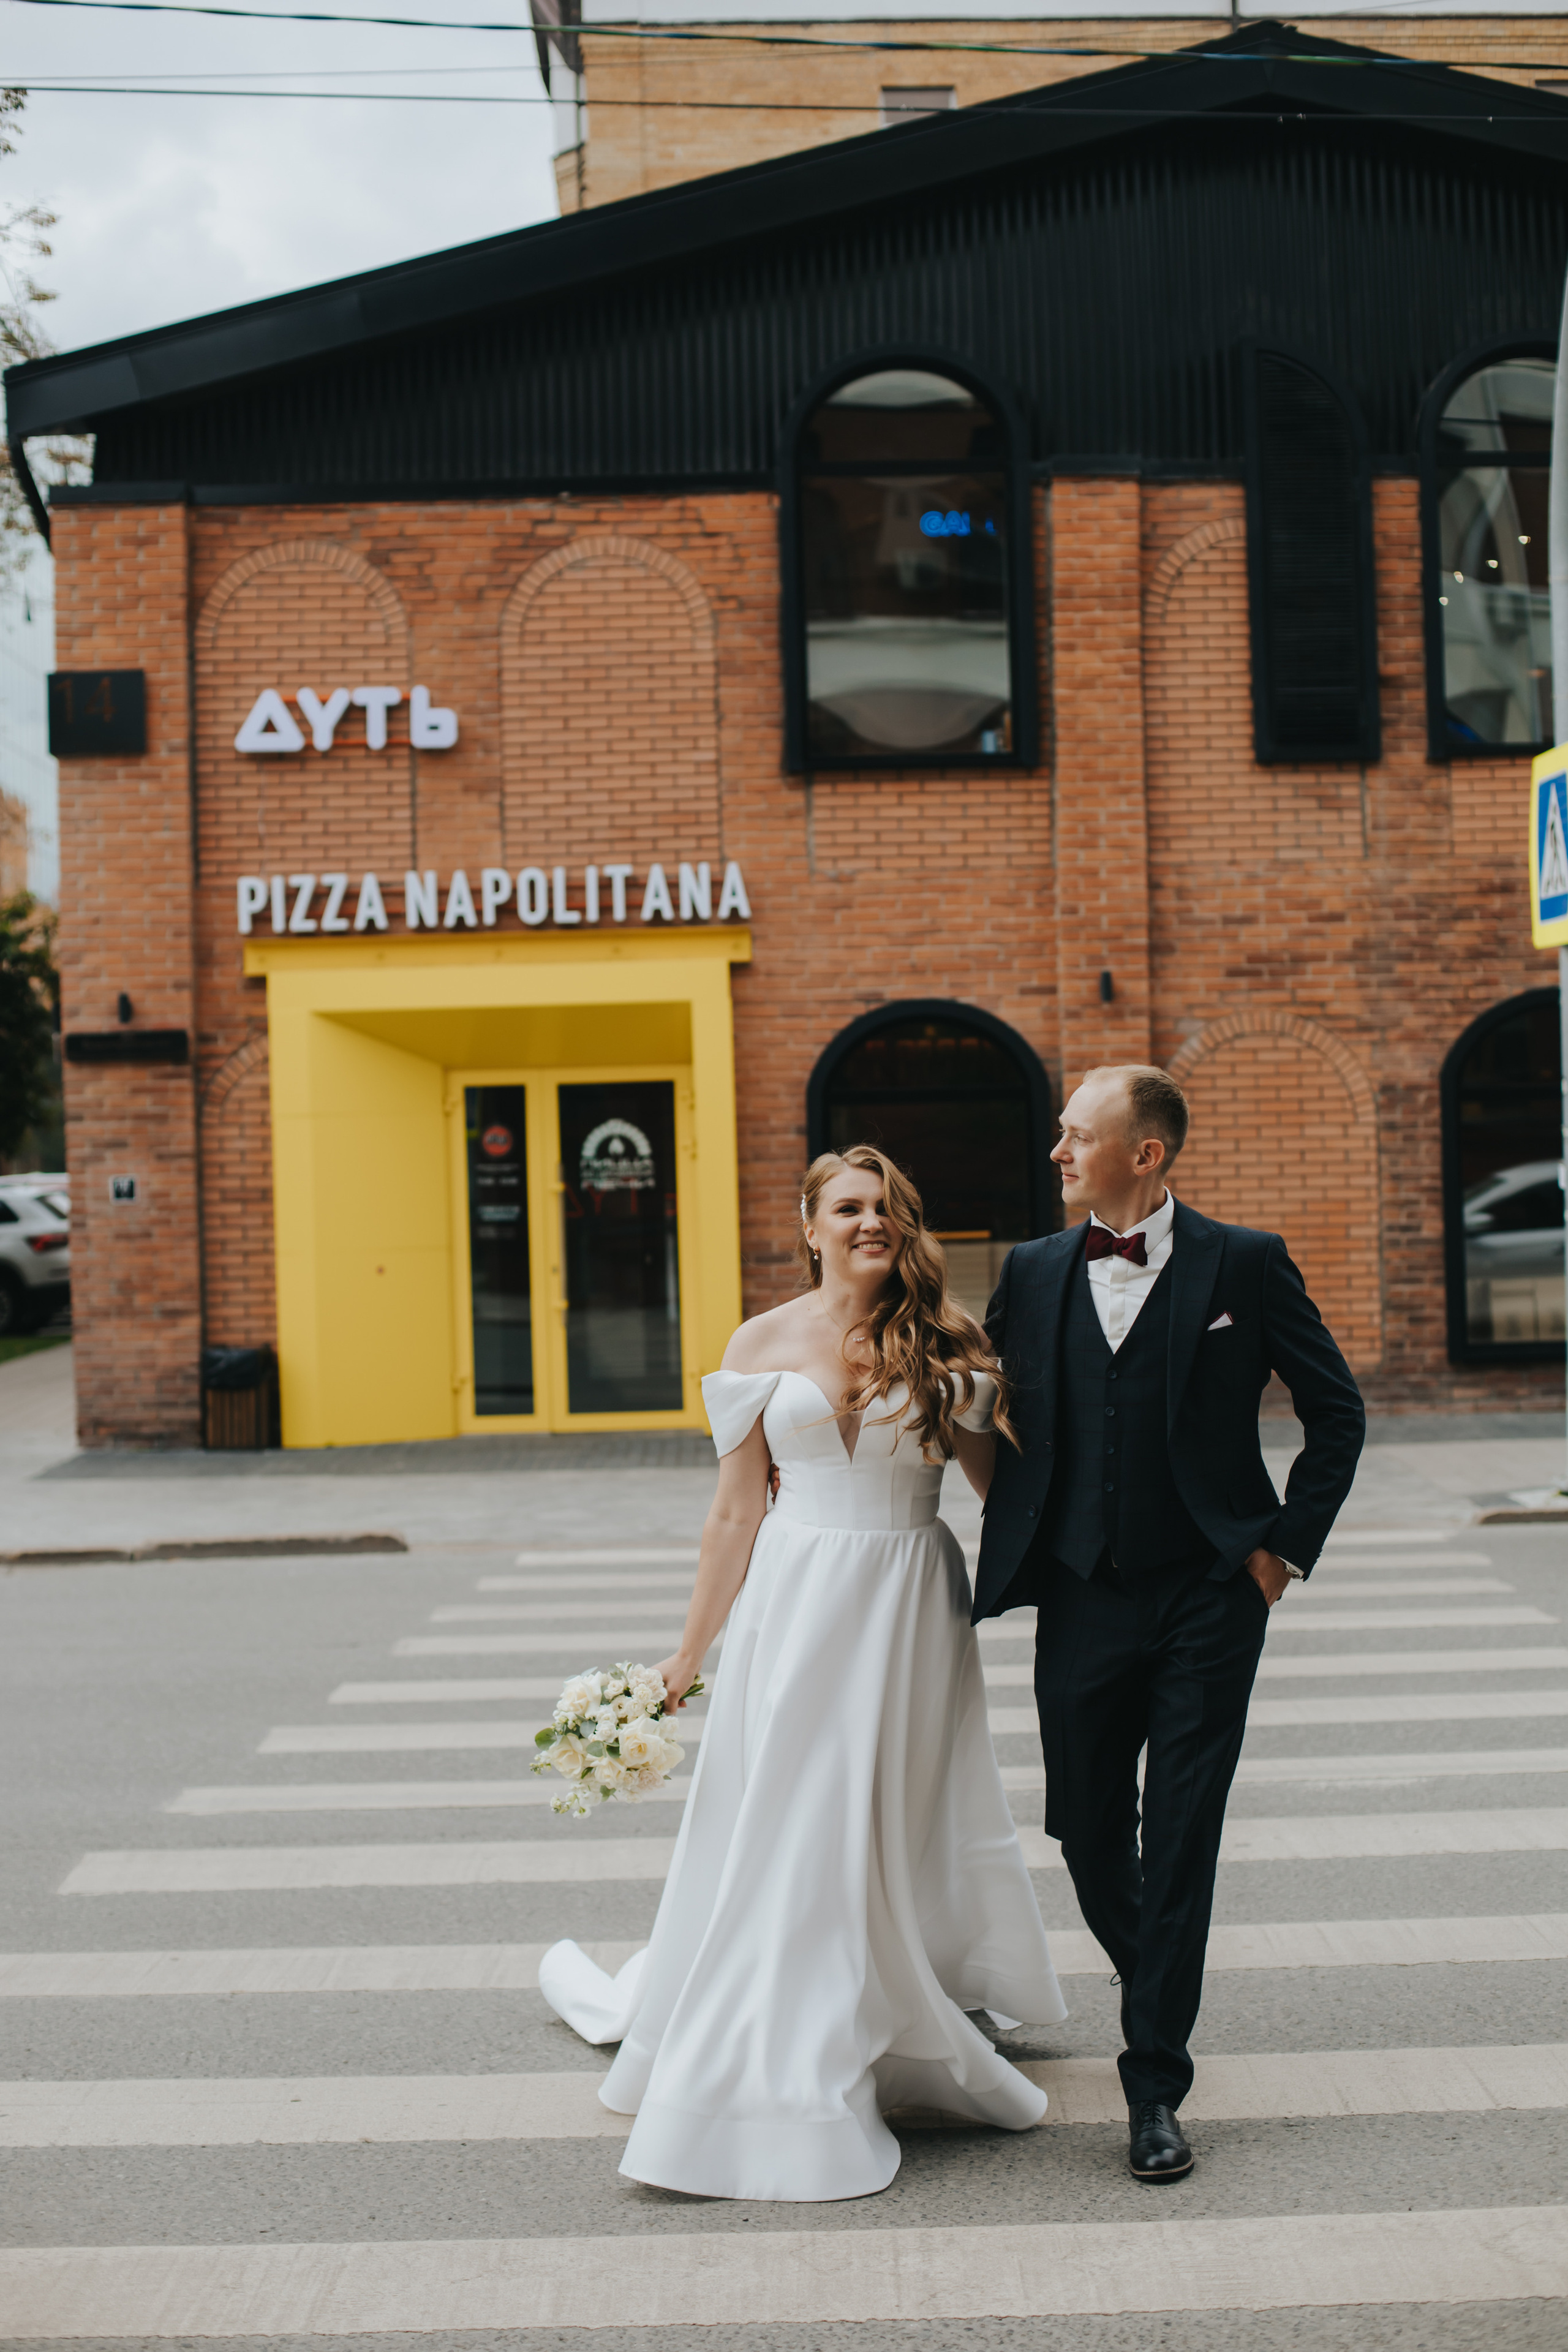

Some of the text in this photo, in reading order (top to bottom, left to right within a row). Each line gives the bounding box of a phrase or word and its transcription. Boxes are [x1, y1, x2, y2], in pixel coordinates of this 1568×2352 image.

[54, 677, 119, 725] 14
[237, 861, 752, 933] PIZZA NAPOLITANA
